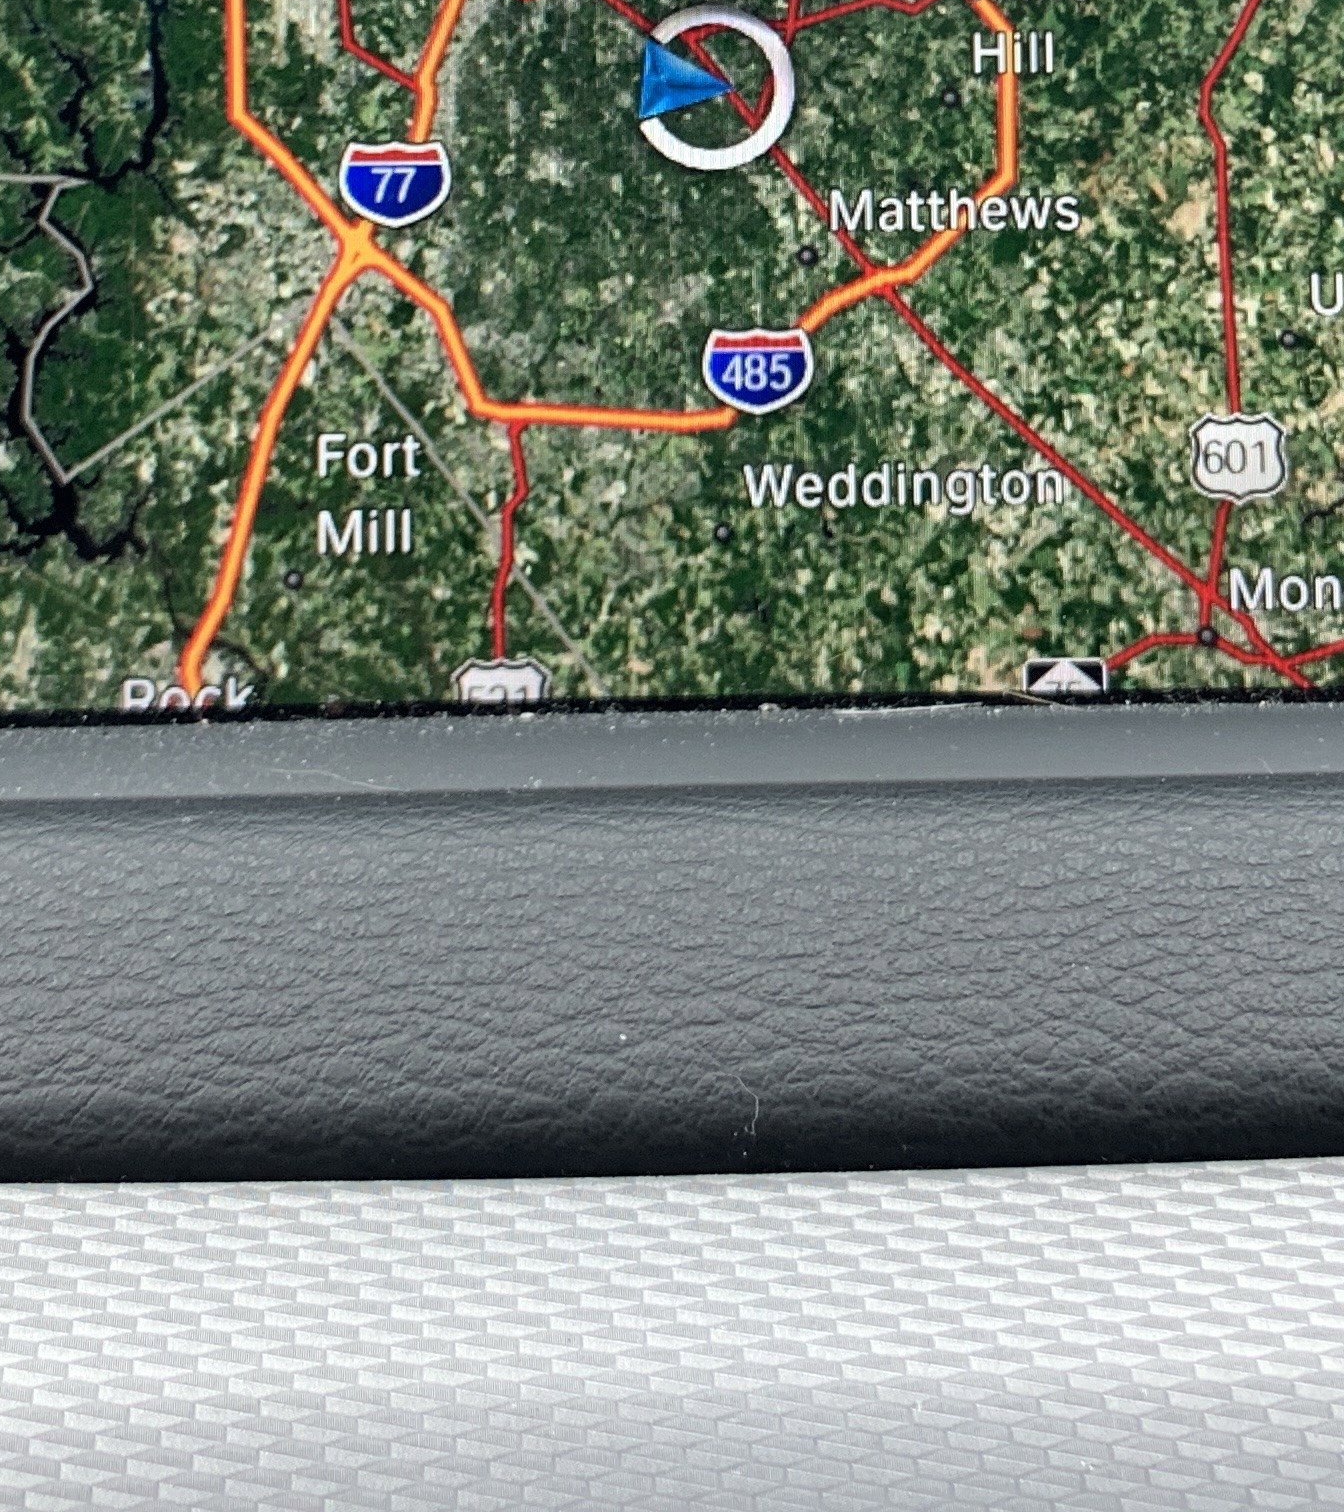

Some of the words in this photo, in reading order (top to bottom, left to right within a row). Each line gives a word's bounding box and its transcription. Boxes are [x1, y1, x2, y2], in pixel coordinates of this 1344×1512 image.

[973, 31, 1056, 74] Hill
[371, 166, 415, 203] 77
[828, 190, 1081, 232] Matthews
[720, 353, 791, 390] 485
[316, 433, 421, 477] Fort
[1203, 439, 1268, 474] 601
[743, 464, 1065, 512] Weddington
[317, 509, 411, 554] Mill
